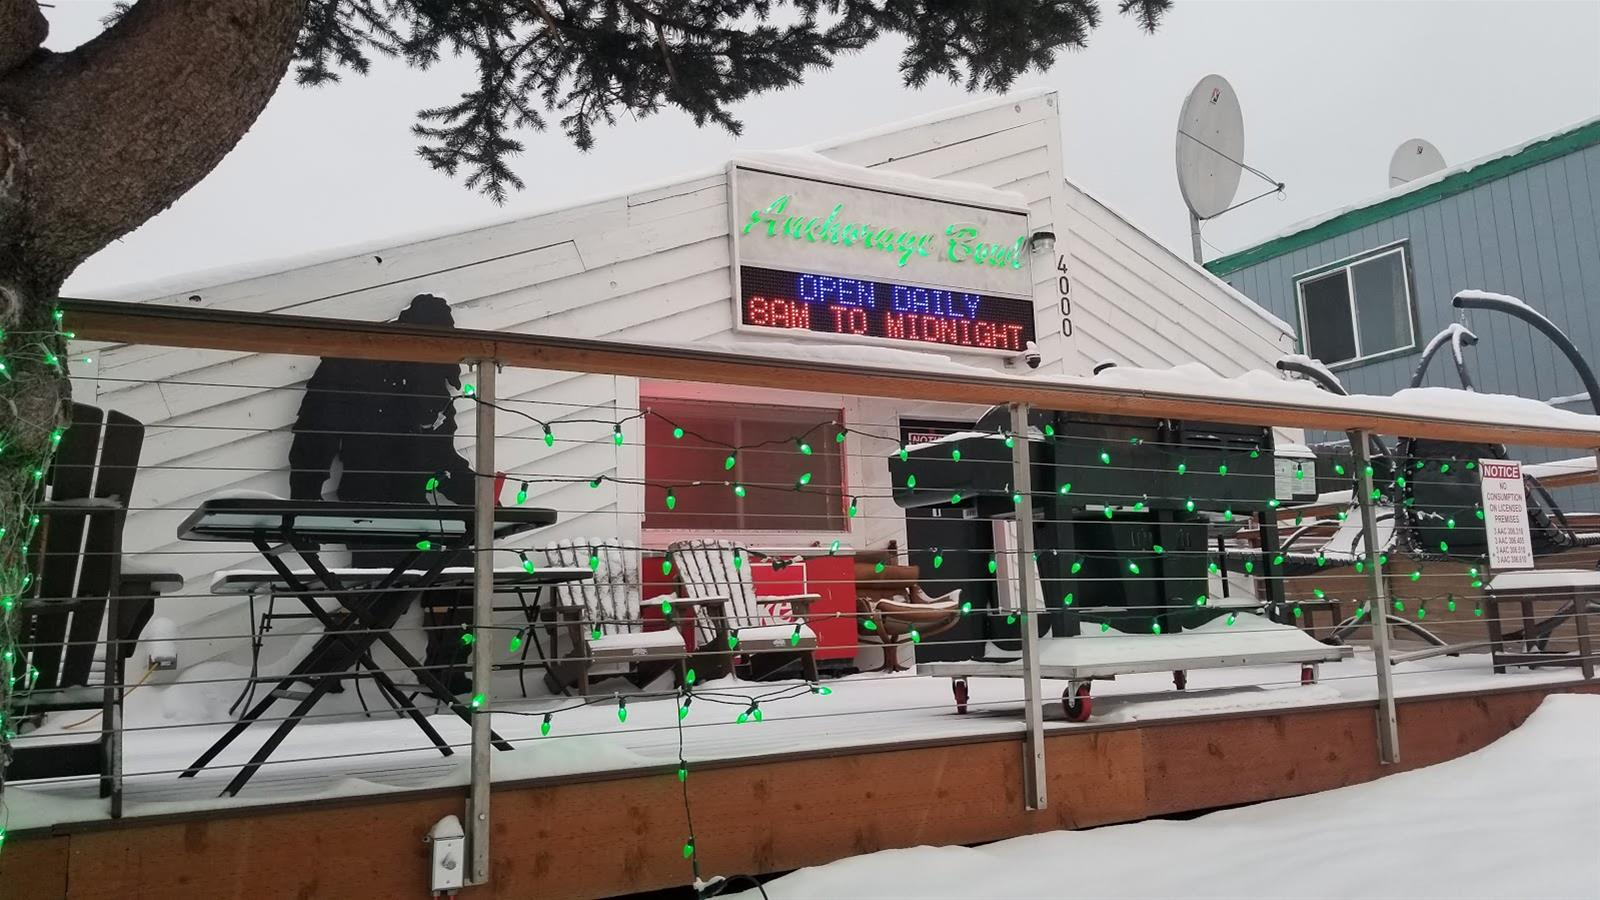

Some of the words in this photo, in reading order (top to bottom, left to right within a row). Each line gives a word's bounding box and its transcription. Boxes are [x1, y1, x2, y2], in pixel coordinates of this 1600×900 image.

[743, 194, 934, 266] Anchorage
[946, 224, 1026, 270] Bowl
[800, 274, 876, 307] OPEN
[894, 285, 980, 318] DAILY
[1057, 255, 1072, 337] 4000
[750, 296, 810, 330] 8AM
[830, 305, 868, 335] TO
[886, 311, 1023, 350] MIDNIGHT
[1484, 465, 1519, 478] NOTICE
[1499, 482, 1507, 490] NO
[1487, 492, 1523, 501] CONSUMPTION
[1490, 503, 1497, 512] ON
[1498, 504, 1523, 512] LICENSED
[1494, 515, 1520, 523] PREMISES
